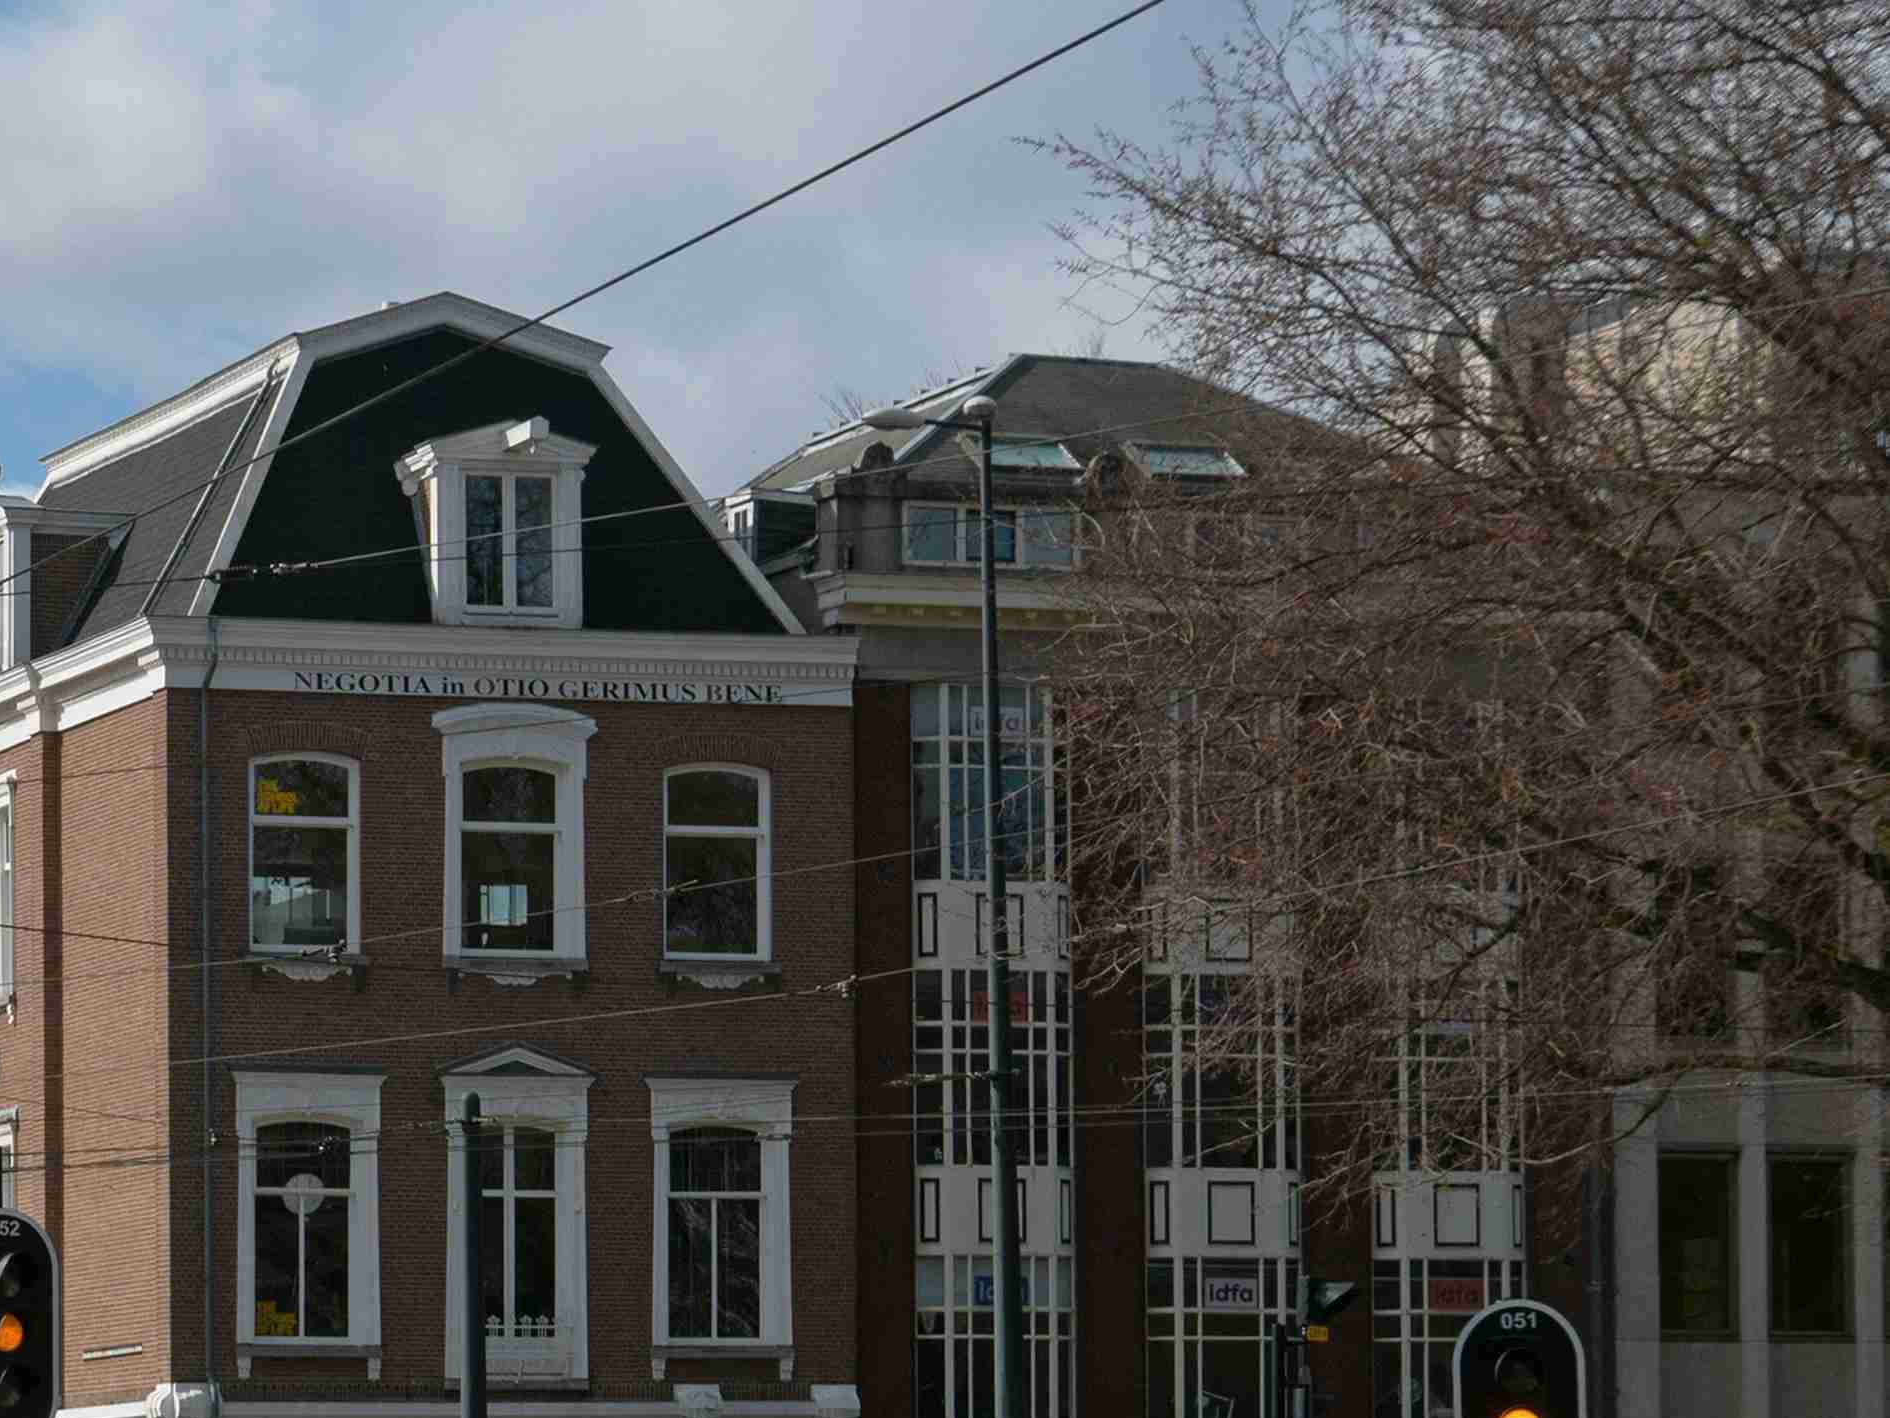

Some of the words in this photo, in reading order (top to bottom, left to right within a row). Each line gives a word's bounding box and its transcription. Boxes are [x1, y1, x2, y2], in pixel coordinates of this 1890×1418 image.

[293, 671, 432, 694] NEGOTIA
[442, 676, 465, 695] in
[473, 676, 550, 698] OTIO
[557, 679, 697, 701] GERIMUS
[706, 683, 783, 703] BENE
[1208, 1283, 1254, 1303] idfa
[1499, 1311, 1537, 1329] 051
